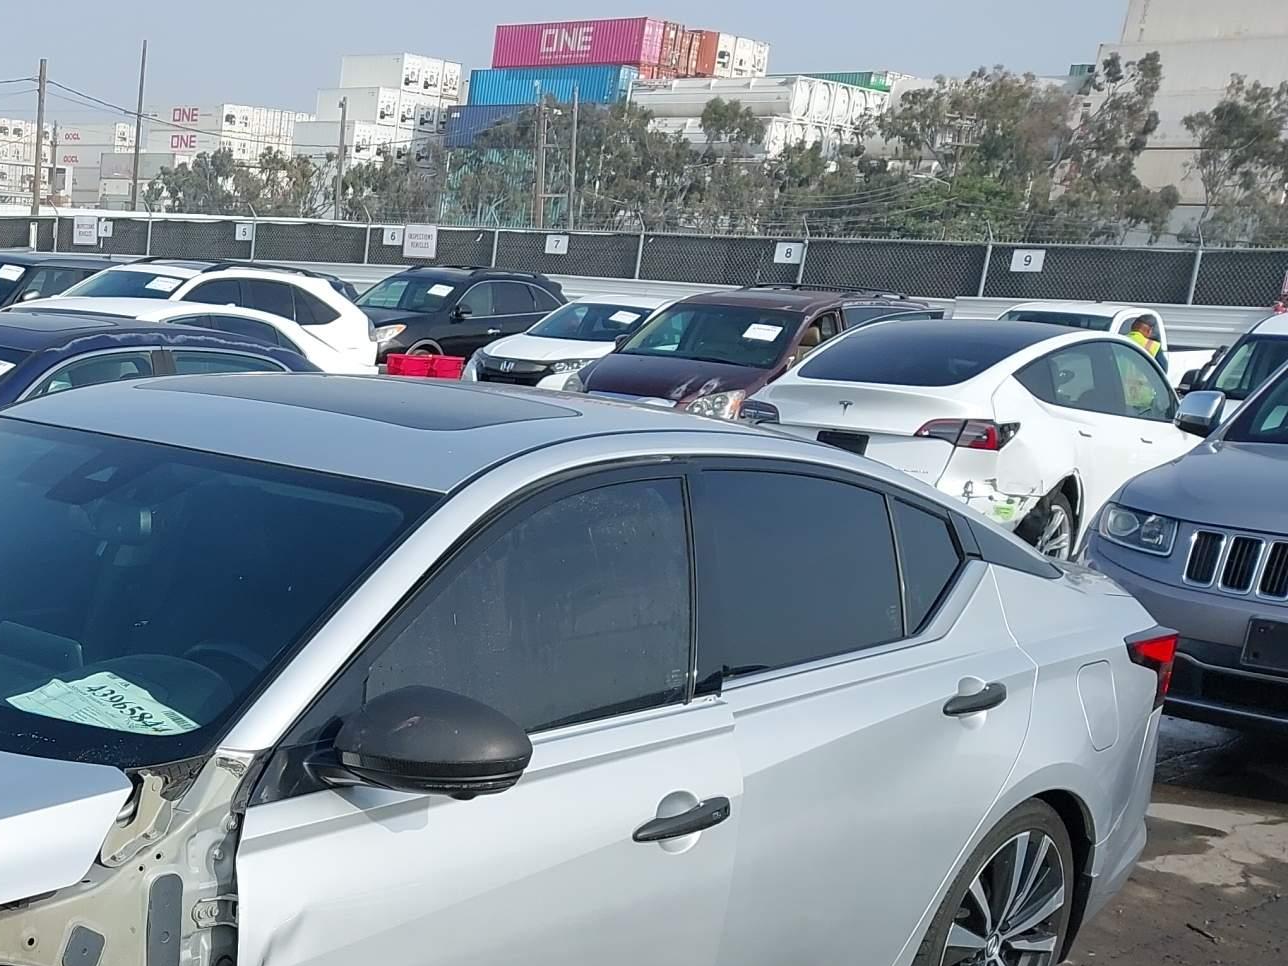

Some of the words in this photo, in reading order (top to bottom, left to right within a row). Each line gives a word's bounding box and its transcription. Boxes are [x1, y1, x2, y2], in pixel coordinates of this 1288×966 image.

[540, 26, 593, 52] ONE
[172, 107, 199, 122] ONE
[170, 134, 197, 149] ONE
[103, 225, 108, 233] 4
[241, 228, 247, 237] 5
[390, 232, 396, 241] 6
[554, 240, 560, 249] 7
[784, 248, 793, 259] 8
[1023, 255, 1032, 266] 9
[86, 685, 173, 732] 43965844
